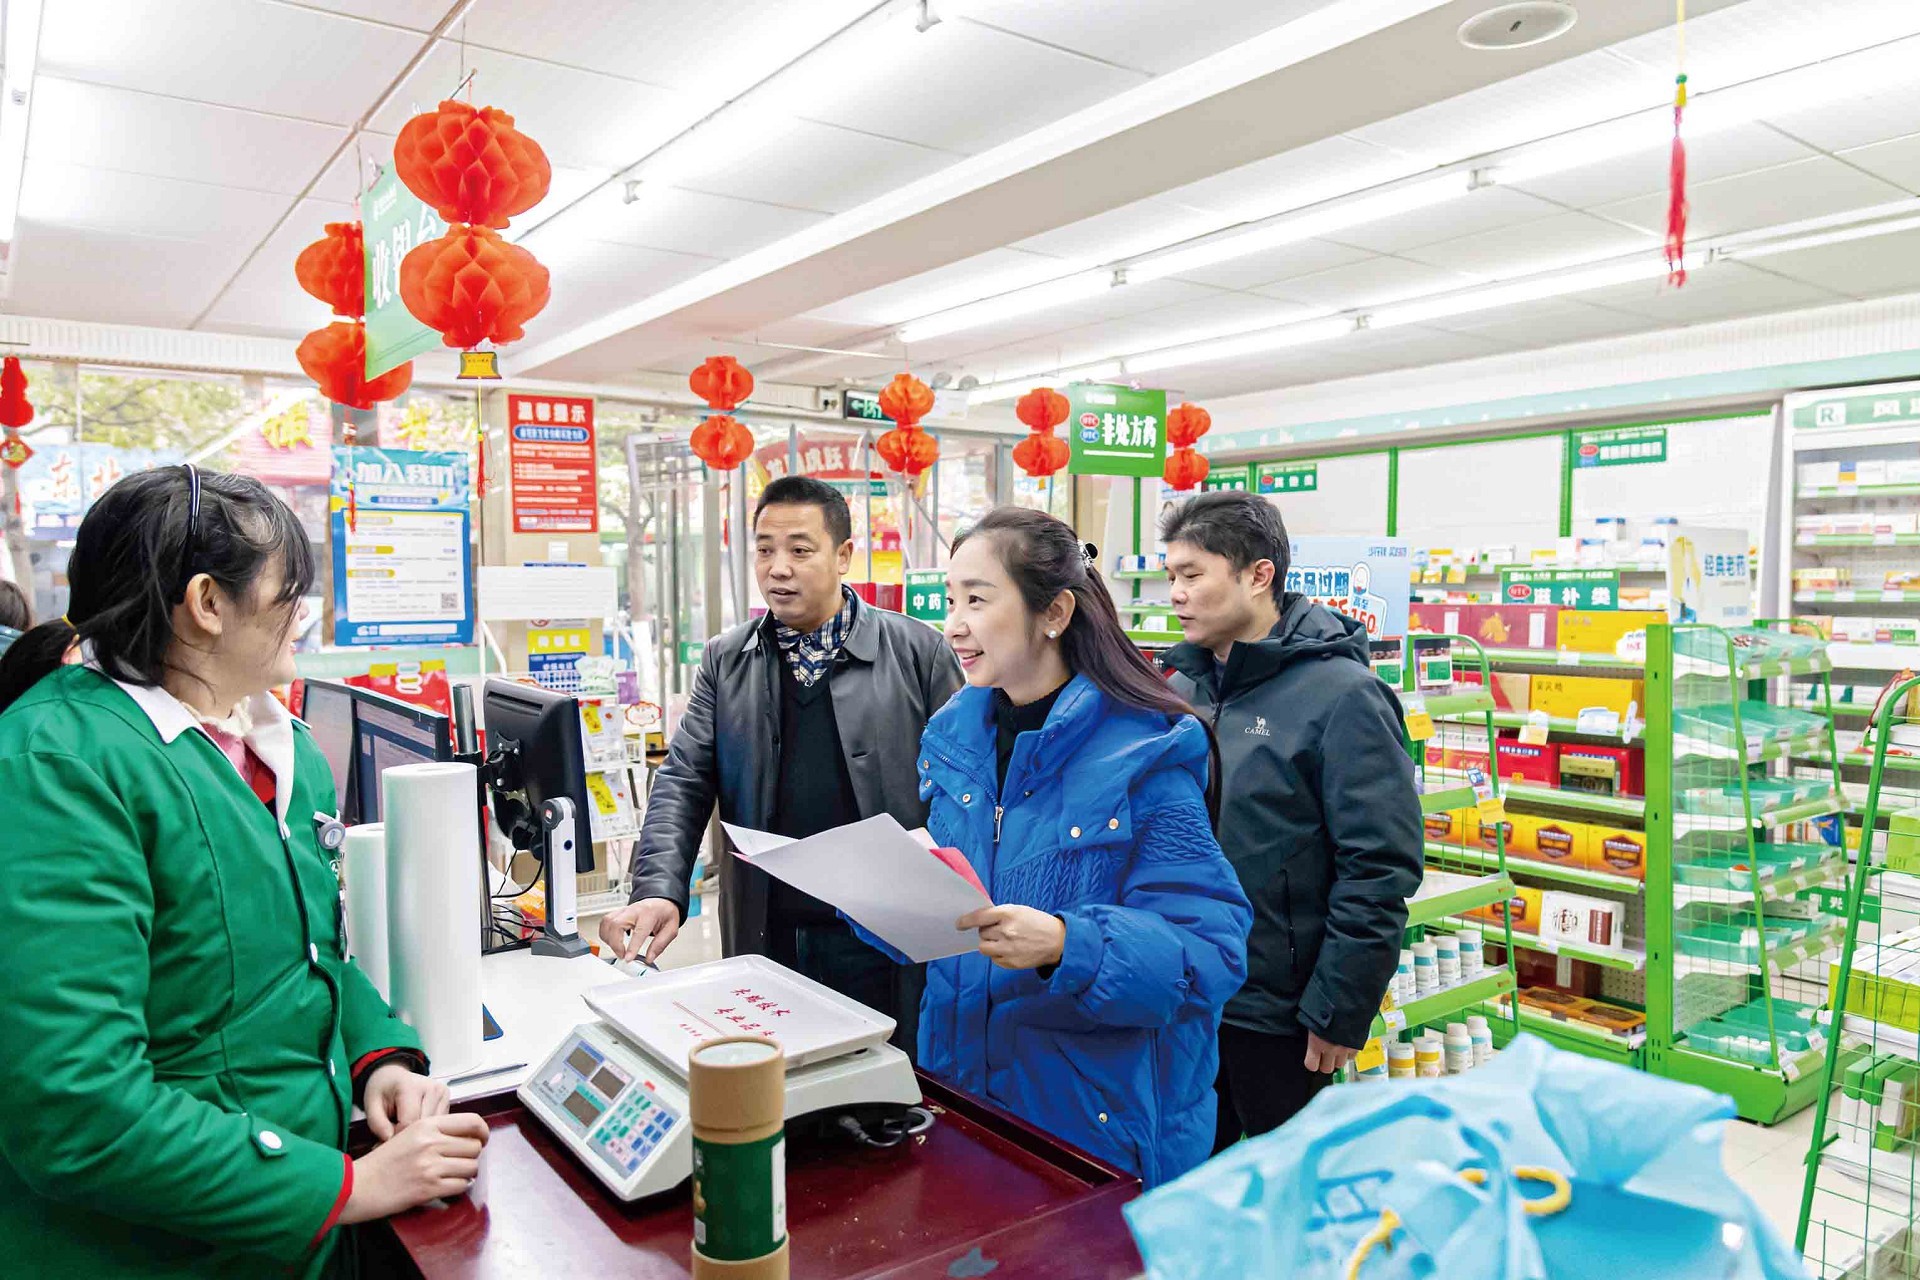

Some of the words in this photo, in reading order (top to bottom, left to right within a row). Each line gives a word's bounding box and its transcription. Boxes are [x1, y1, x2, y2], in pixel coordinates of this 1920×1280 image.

[1101, 412, 1157, 448] 非处方药
[912, 593, 950, 611] 中药
[1245, 727, 1270, 737] CAMEL
